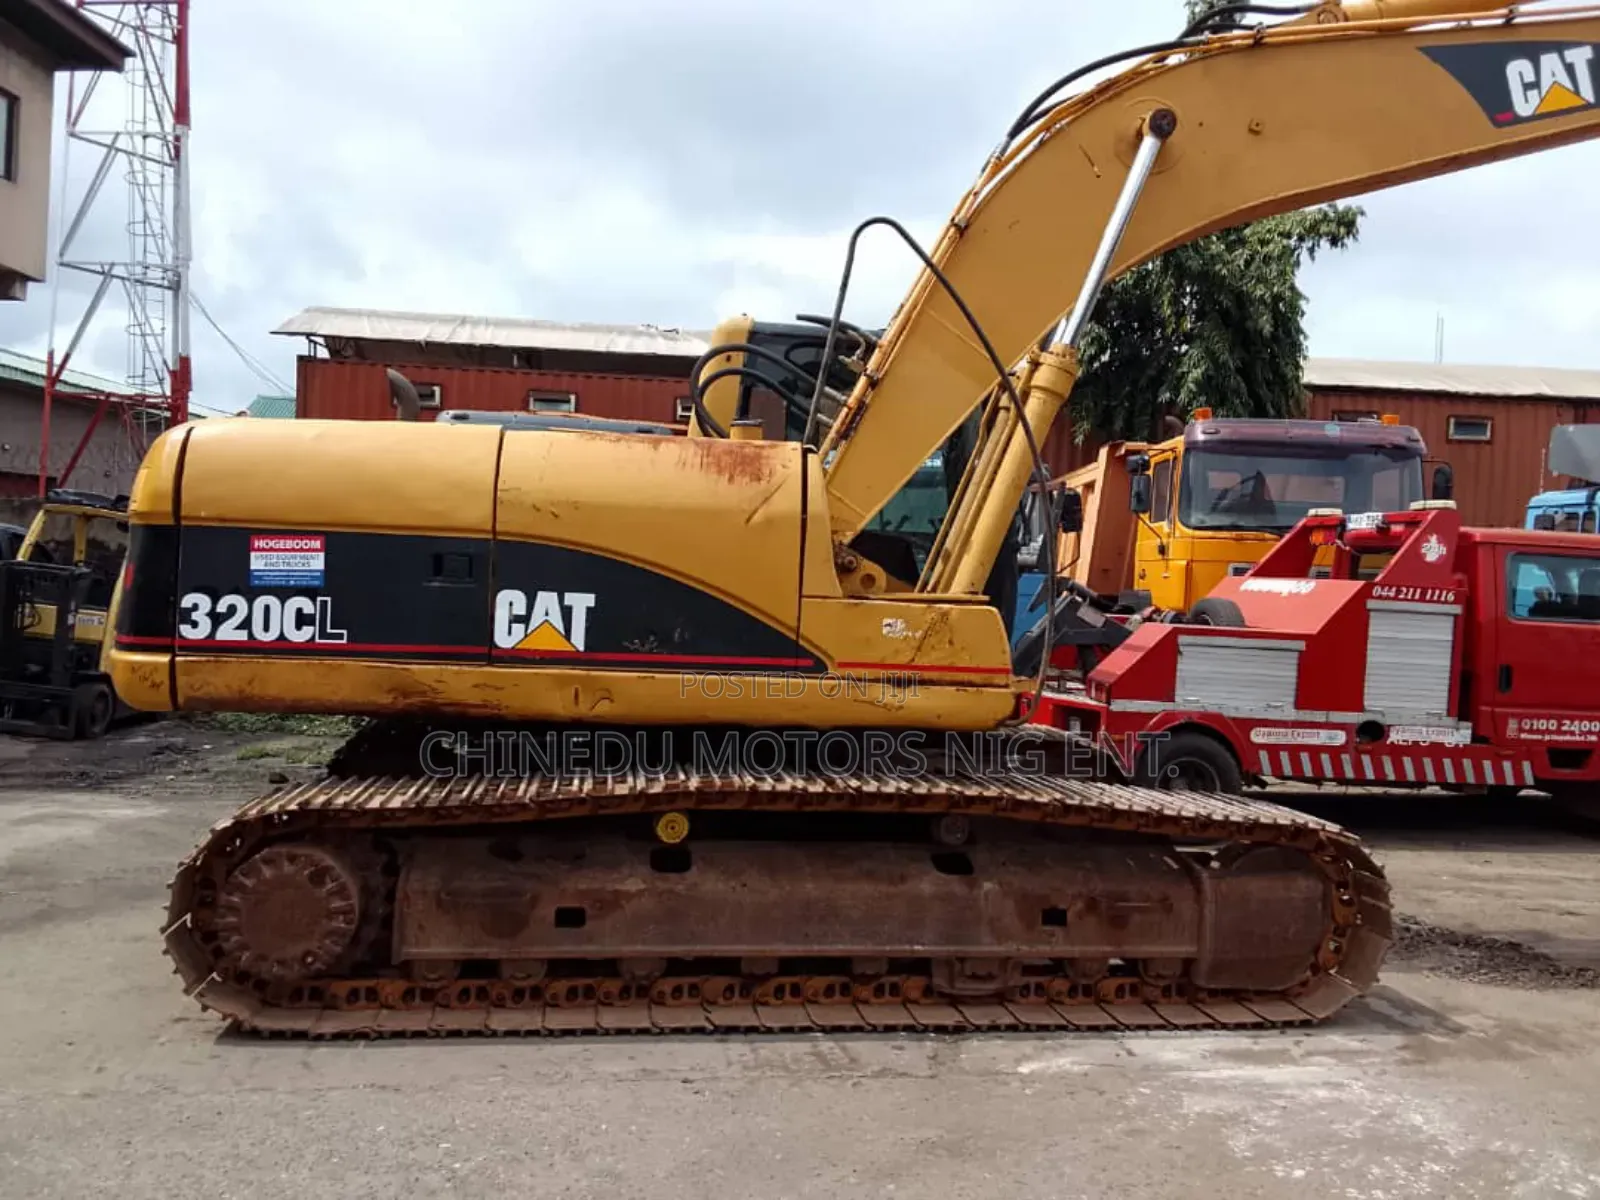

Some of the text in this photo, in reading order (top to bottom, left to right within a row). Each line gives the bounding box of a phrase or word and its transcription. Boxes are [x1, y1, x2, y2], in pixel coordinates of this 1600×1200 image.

[1505, 45, 1595, 117] CAT
[254, 538, 321, 549] HOGEBOOM
[281, 561, 311, 569] TRUCKS
[1372, 585, 1456, 603] 044 211 1116
[179, 592, 348, 643] 320CL
[493, 589, 596, 652] CAT
[1521, 719, 1557, 730] 0100
